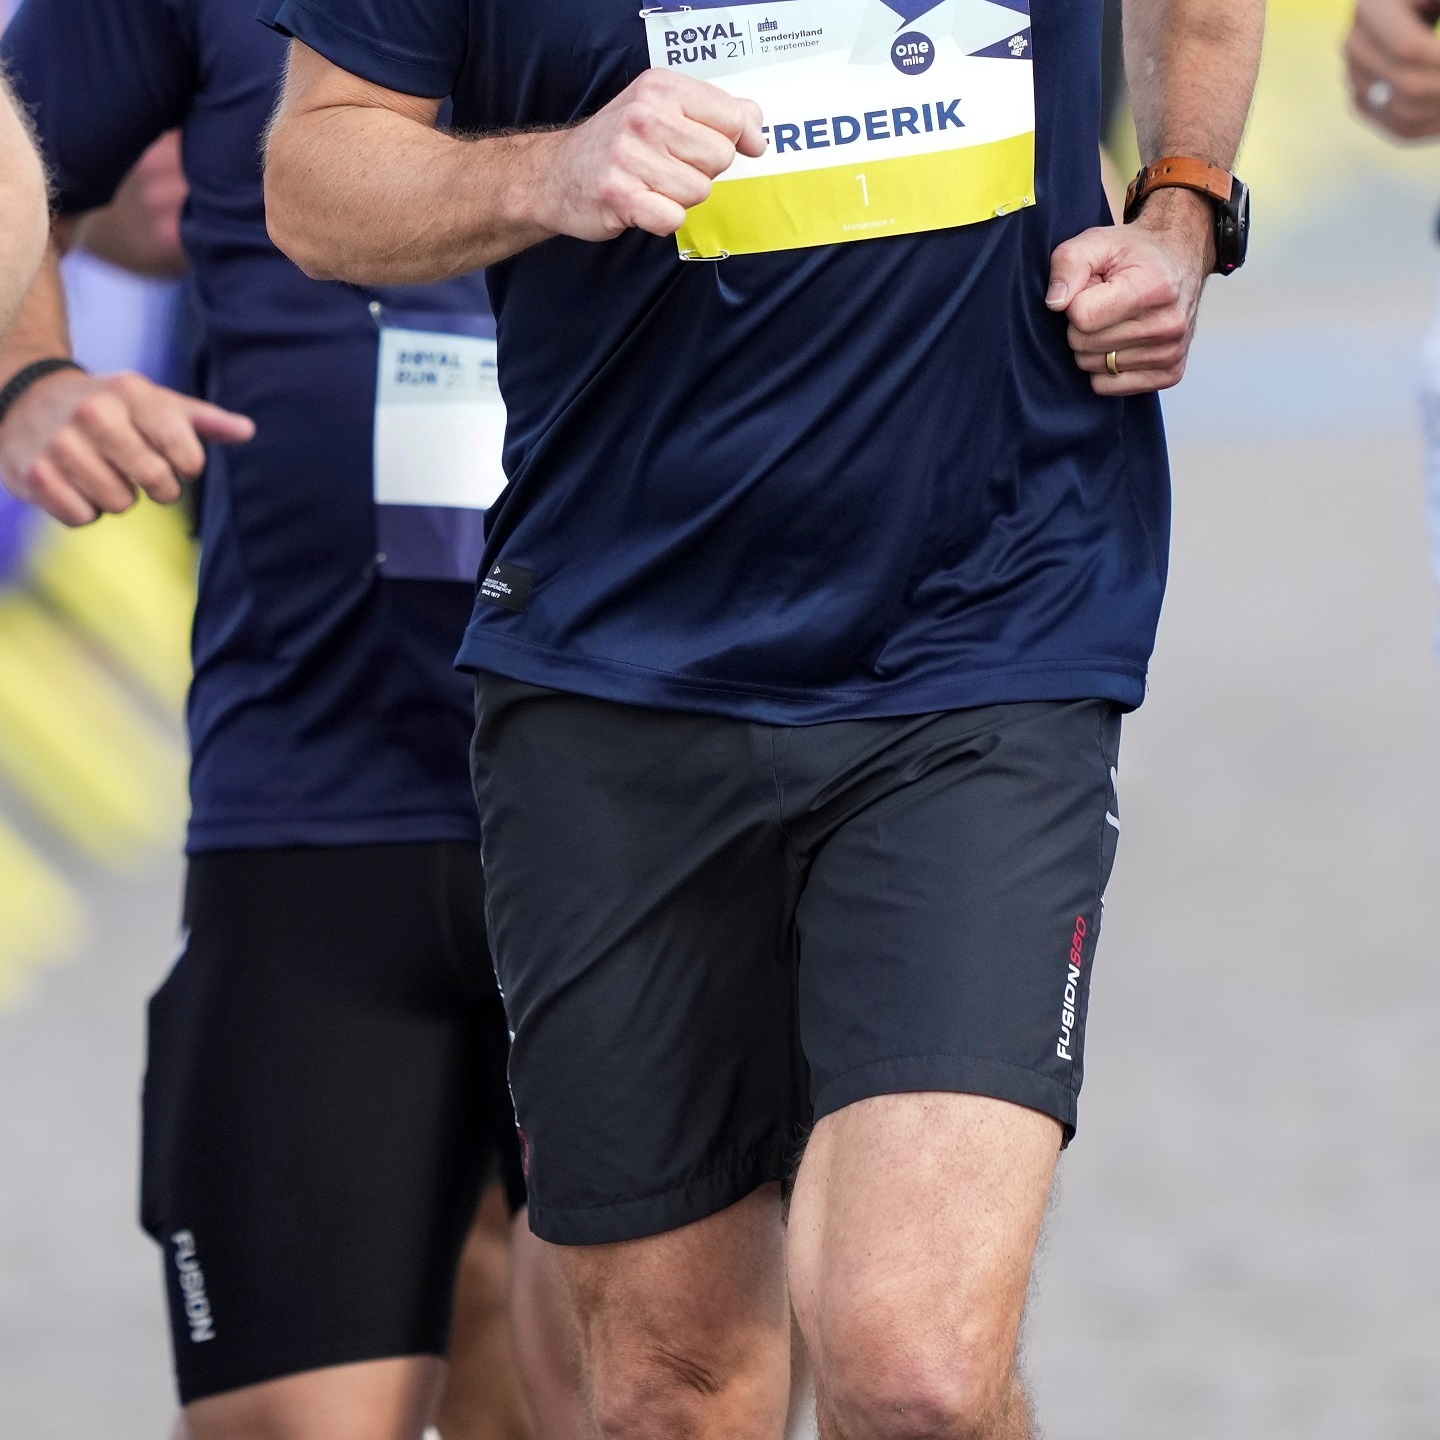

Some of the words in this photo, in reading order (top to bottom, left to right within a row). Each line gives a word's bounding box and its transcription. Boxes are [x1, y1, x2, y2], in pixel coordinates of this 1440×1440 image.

[664, 22, 743, 47] ROYAL
[759, 28, 824, 43] Sønderjylland
[666, 44, 717, 66] RUN
[773, 39, 820, 53] september
[895, 41, 929, 57] one
[902, 55, 925, 67] mile
[762, 98, 965, 154] REDERIK
[855, 173, 870, 207] 1
